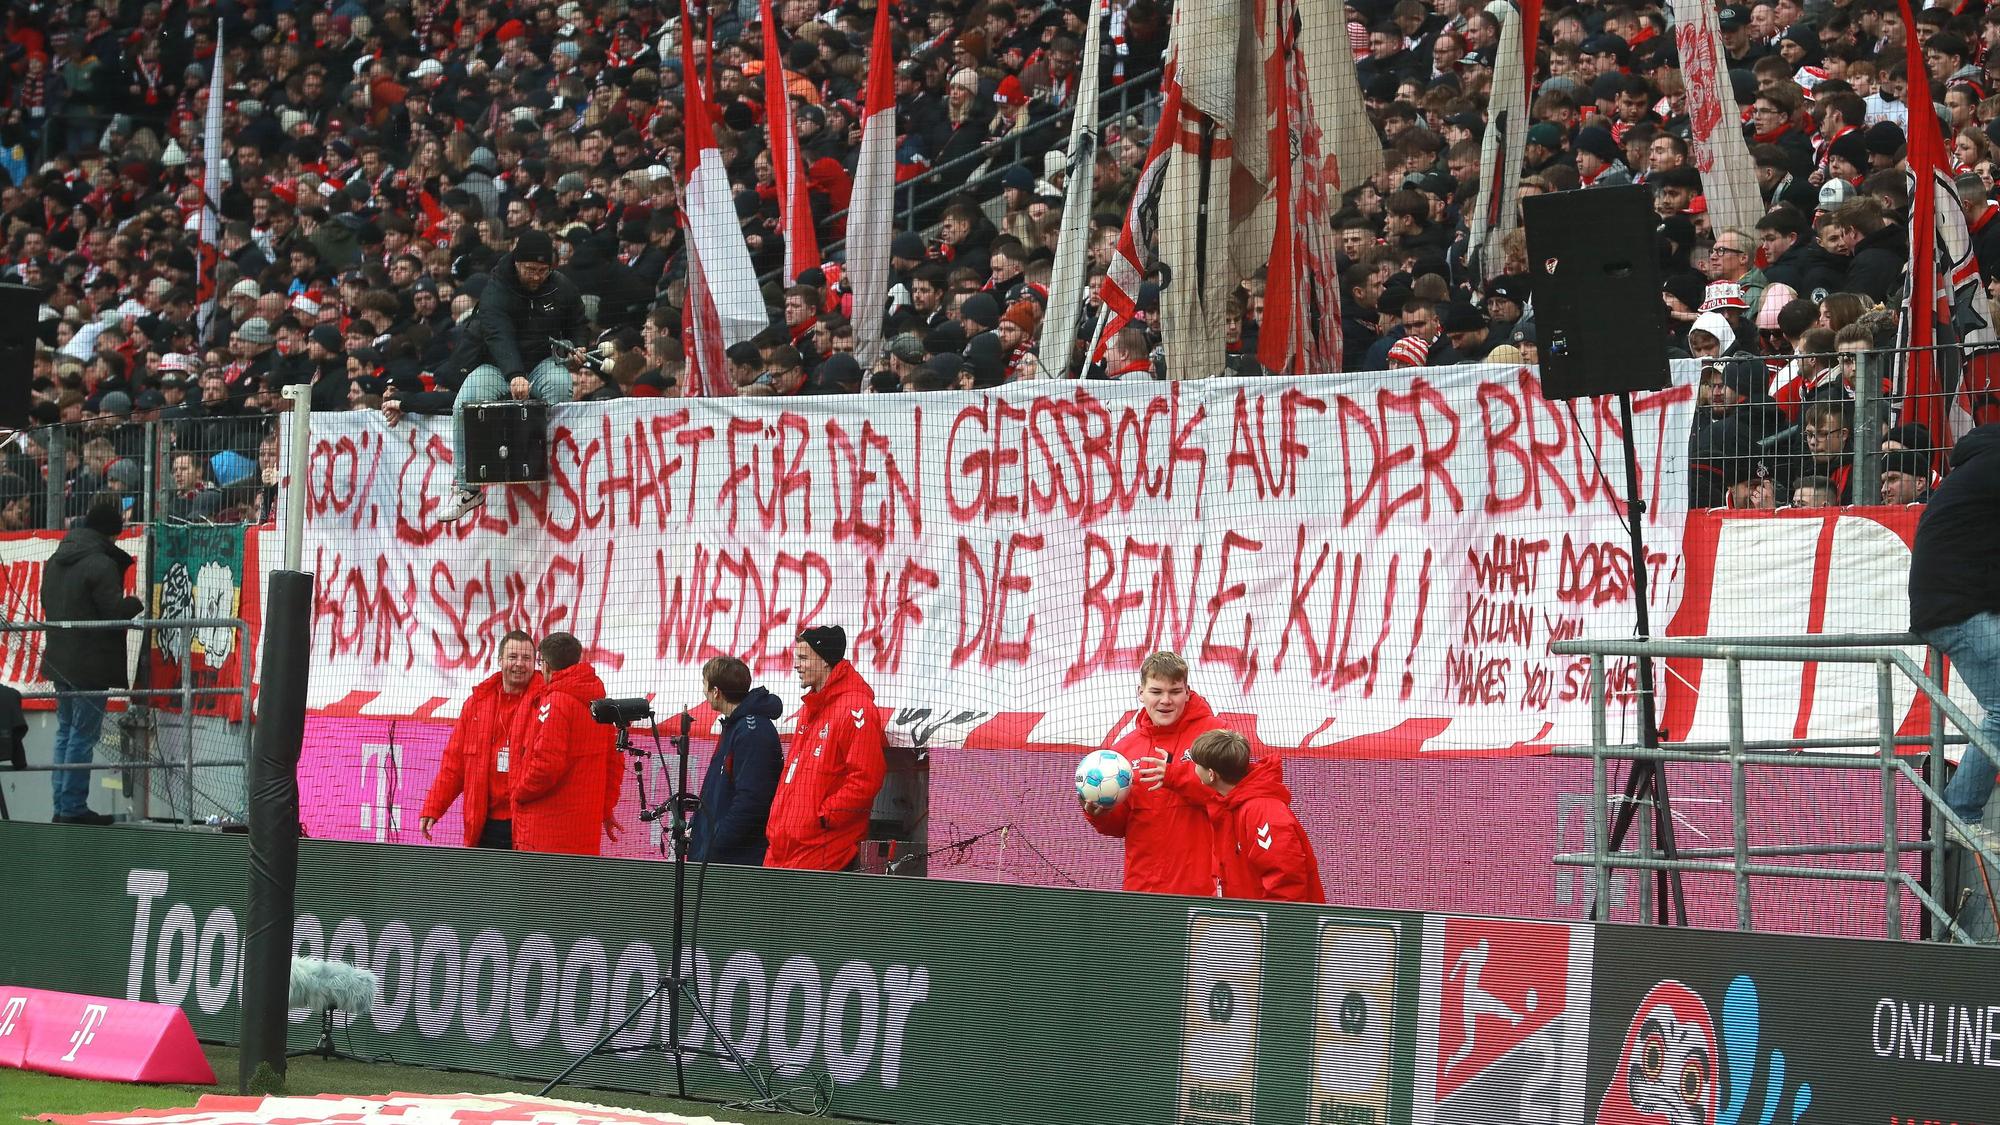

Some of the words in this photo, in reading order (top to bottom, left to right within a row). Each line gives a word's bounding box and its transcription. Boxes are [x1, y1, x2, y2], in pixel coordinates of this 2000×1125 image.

[397, 407, 715, 546] LENSCHAFT
[716, 411, 812, 537] FÜR
[826, 405, 922, 553] DEN
[945, 380, 1206, 527] GEISSBOCK
[1227, 386, 1326, 500] AUF
[1337, 377, 1464, 535] DER
[1477, 367, 1693, 526] BRUST
[1468, 533, 1550, 595] WHAT
[310, 545, 417, 672] KOMM
[431, 540, 625, 673] SCHNELL
[656, 543, 833, 676] WIEDER
[852, 555, 939, 676] AUF
[950, 532, 1044, 671] DIE
[1063, 529, 1263, 695] BEINE,
[1273, 523, 1432, 702] KILI!
[1464, 591, 1533, 649] KILIAN
[1445, 644, 1511, 706] MAKES
[1520, 660, 1554, 712] YOU
[1872, 997, 2000, 1068] ONLINE
